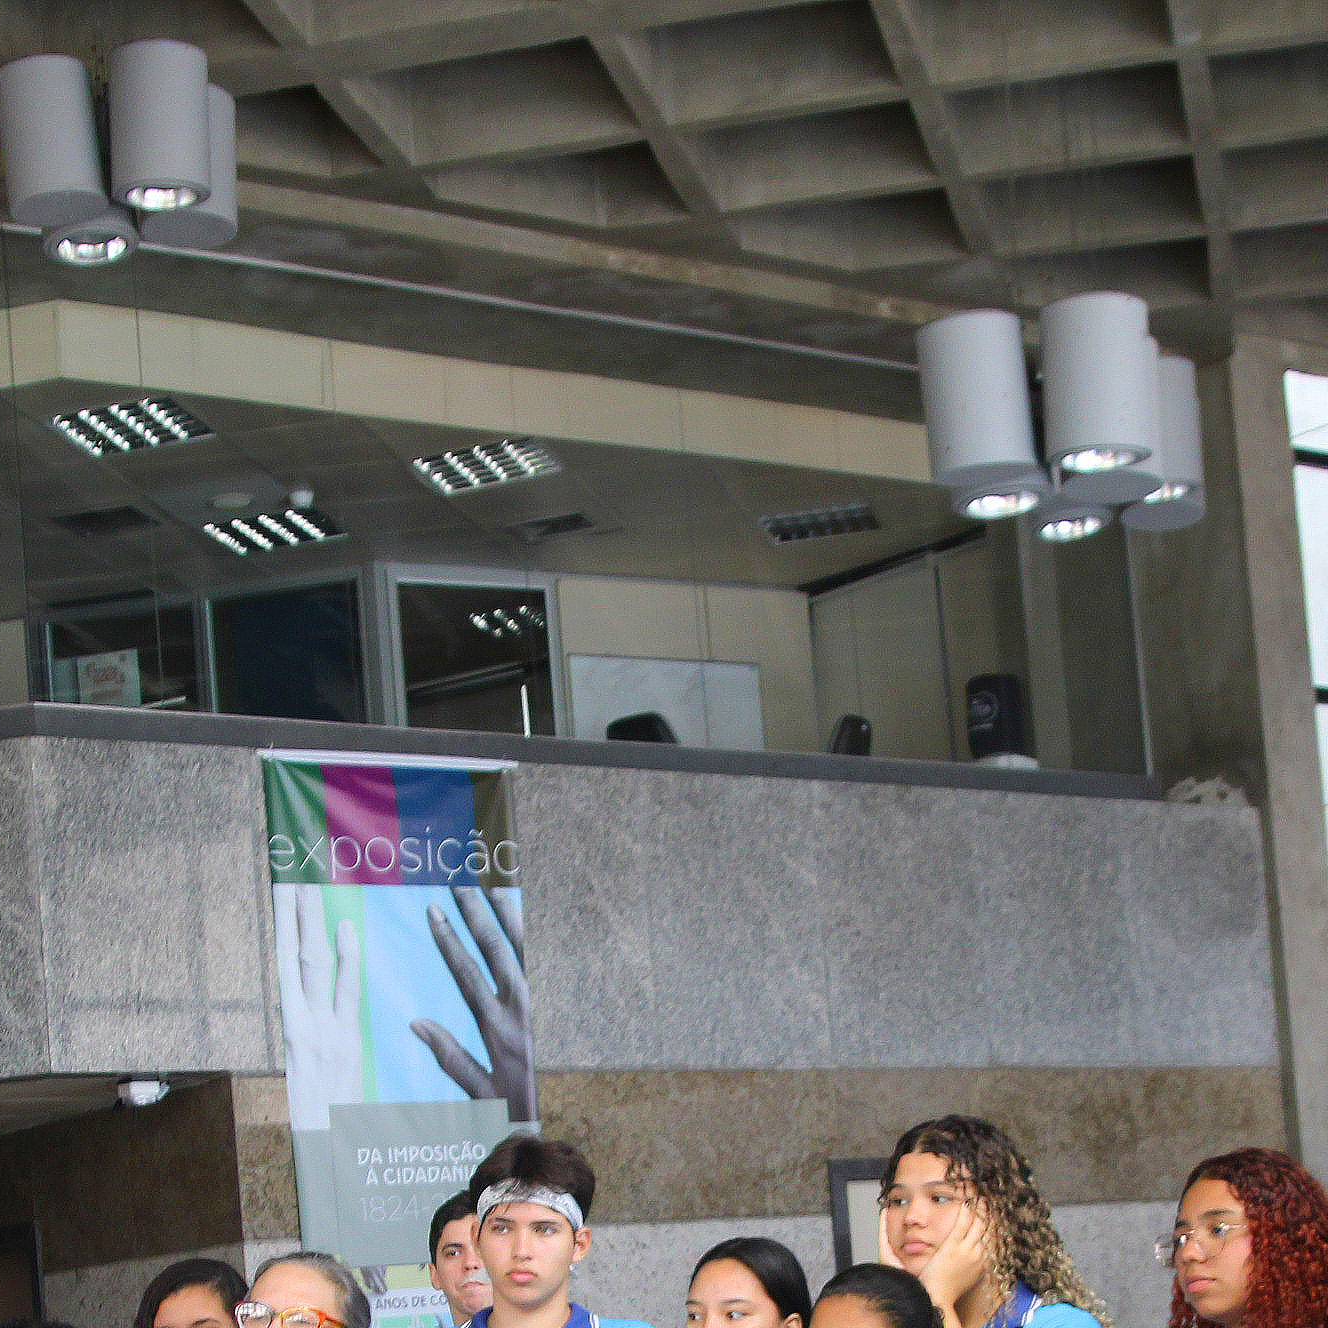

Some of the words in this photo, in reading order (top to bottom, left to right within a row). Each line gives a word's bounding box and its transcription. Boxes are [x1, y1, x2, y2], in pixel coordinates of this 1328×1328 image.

[268, 825, 522, 882] exposição
[357, 1147, 383, 1165] DA
[388, 1140, 486, 1166] IMPOSIÇÃO
[375, 1296, 408, 1310] ANOS
[411, 1294, 429, 1308] DE
